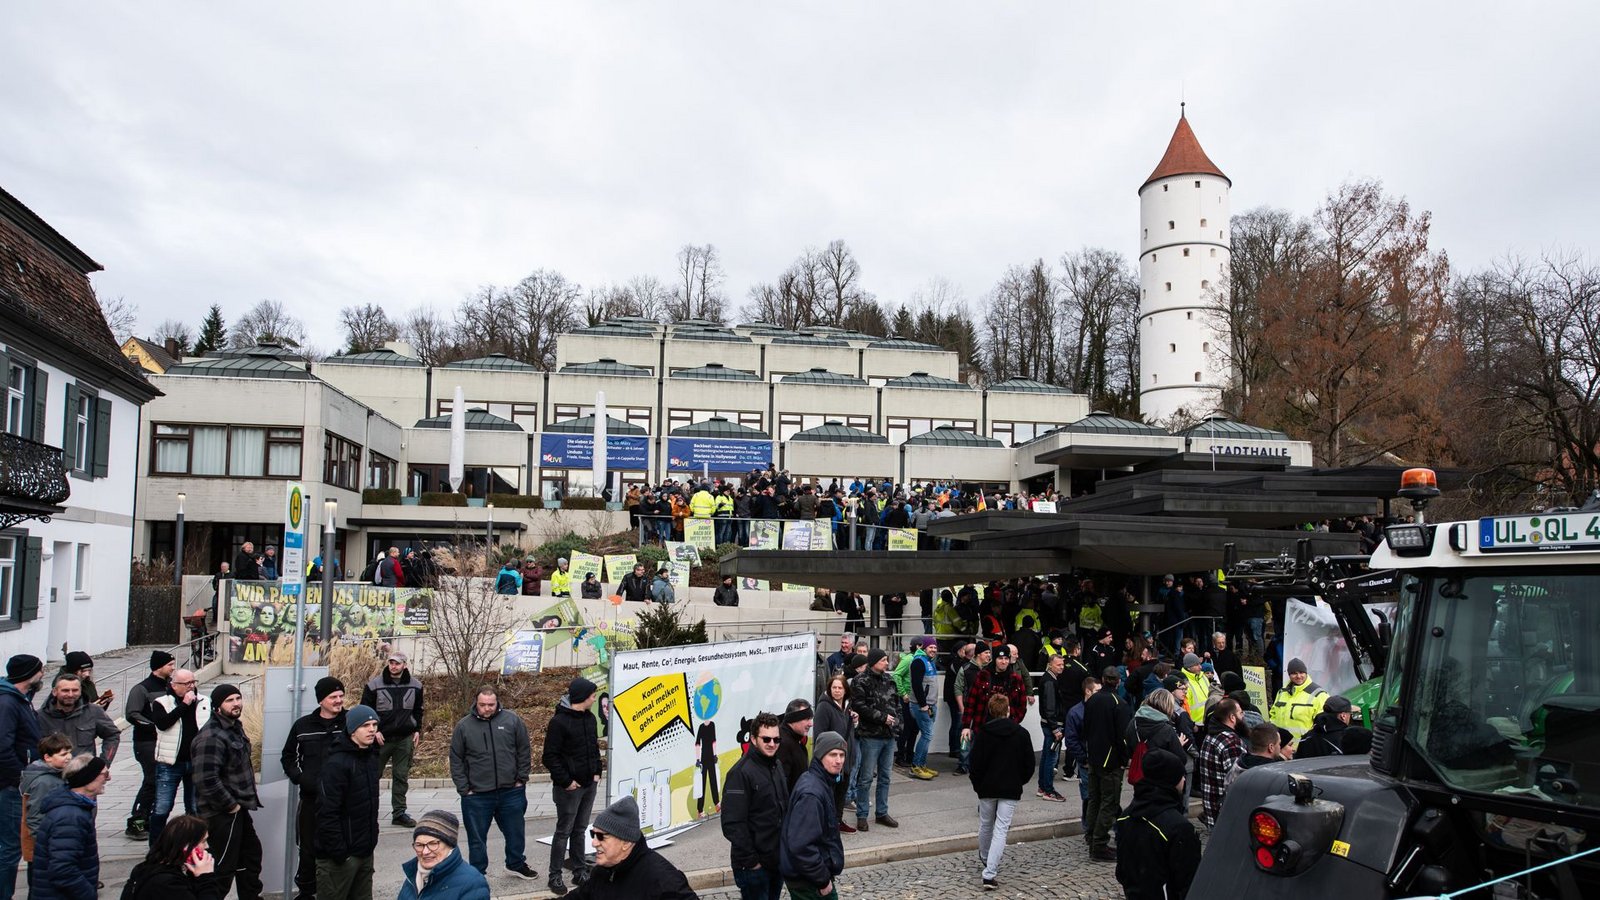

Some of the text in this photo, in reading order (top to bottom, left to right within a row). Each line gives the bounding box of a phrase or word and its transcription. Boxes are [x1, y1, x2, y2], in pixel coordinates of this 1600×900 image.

[1210, 445, 1288, 457] STADTHALLE
[1496, 516, 1600, 543] UL QL 4
[236, 583, 264, 603] WIR
[358, 585, 392, 607] ÜBEL
[242, 642, 267, 661] AN
[622, 663, 640, 671] Maut,
[642, 660, 660, 670] Rente,
[674, 656, 697, 666] Energie,
[698, 651, 748, 662] Gesundheitssystem,
[768, 645, 783, 654] TRIFFT
[632, 685, 680, 722] einmal melken
[642, 682, 664, 700] Komm,
[640, 698, 676, 732] geht noch!!!
